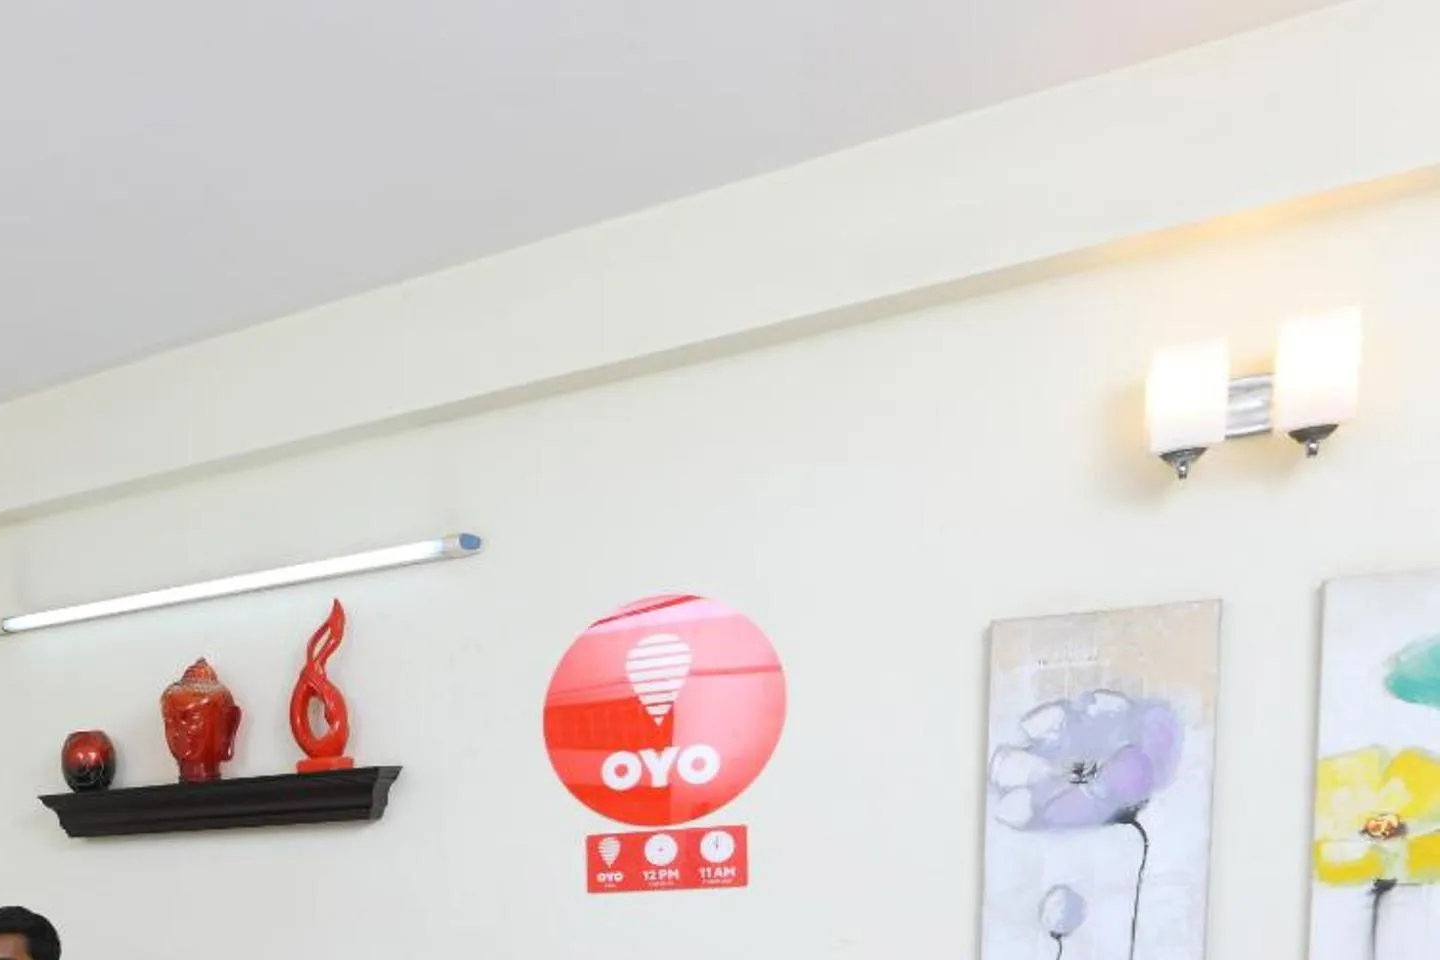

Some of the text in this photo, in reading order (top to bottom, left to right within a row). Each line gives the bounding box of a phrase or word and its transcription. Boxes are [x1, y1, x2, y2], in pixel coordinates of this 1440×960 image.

[601, 744, 721, 791] OYO
[597, 871, 624, 882] OYO
[643, 869, 679, 880] 12 PM
[699, 866, 736, 878] 11 AM
